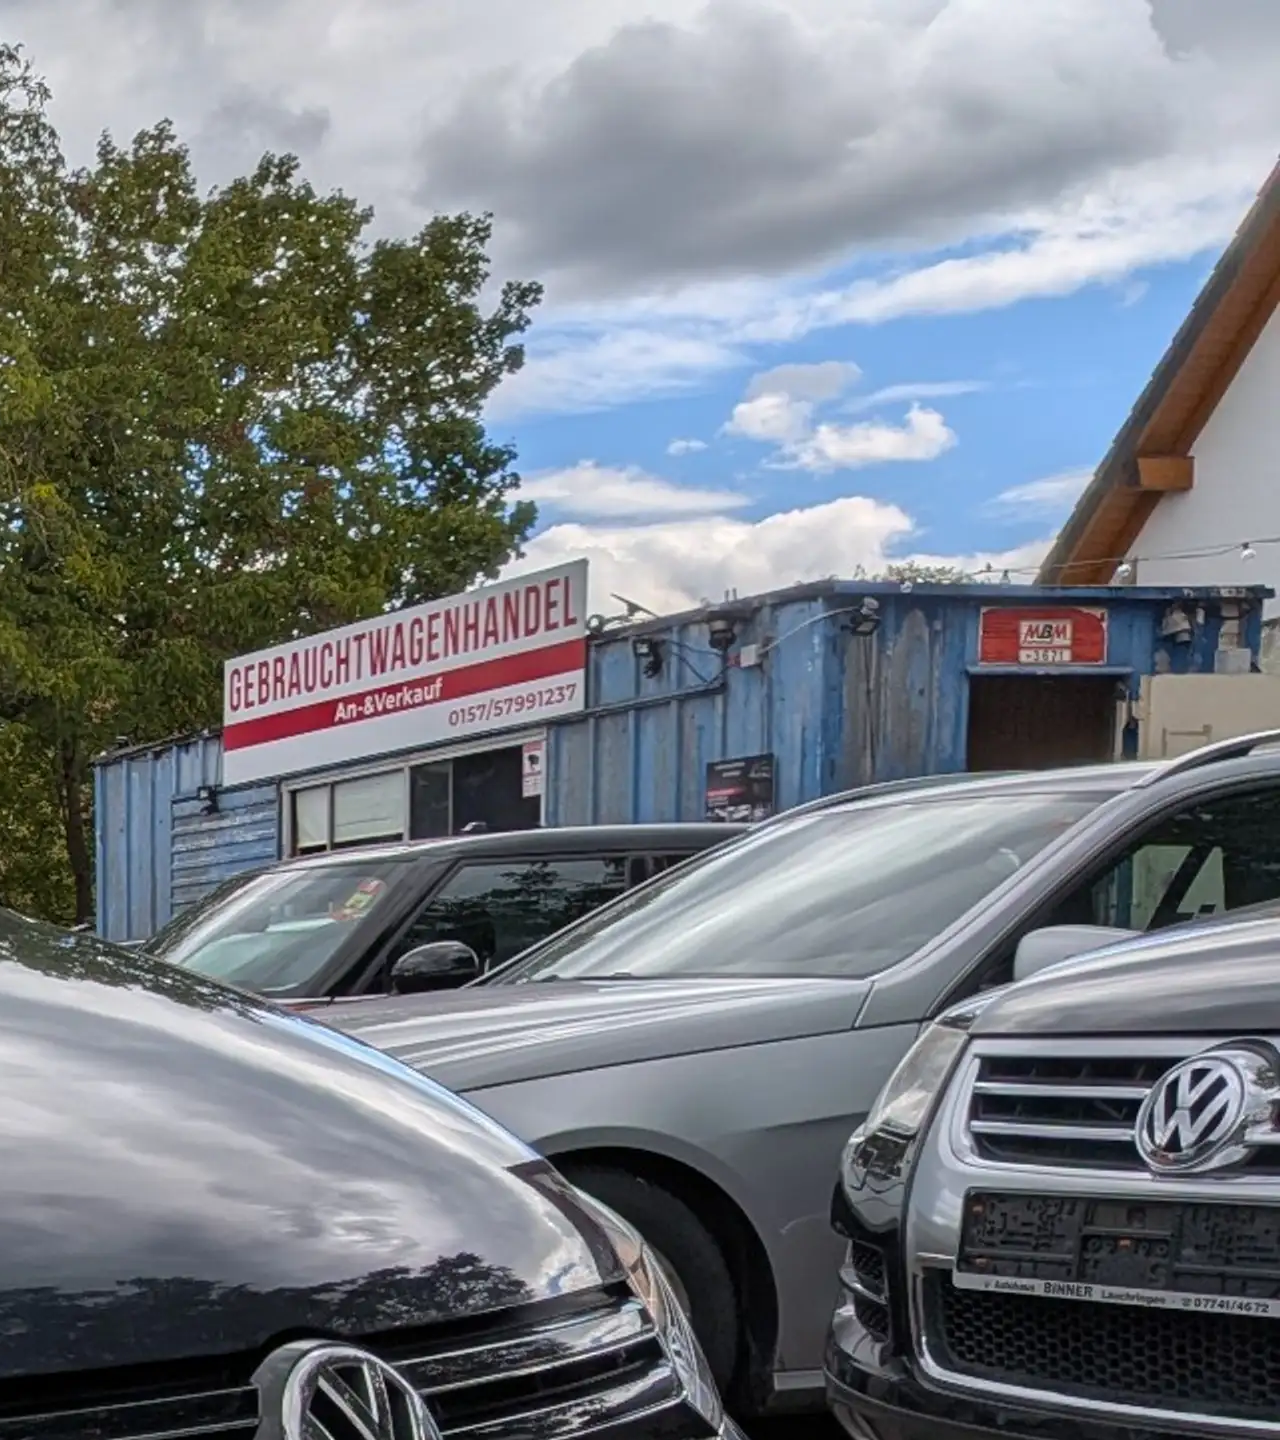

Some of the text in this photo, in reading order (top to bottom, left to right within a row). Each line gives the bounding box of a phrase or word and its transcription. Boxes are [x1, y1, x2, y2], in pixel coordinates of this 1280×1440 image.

[229, 576, 577, 712] GEBRAUCHTWAGENHANDEL
[1023, 624, 1068, 643] MBM
[334, 677, 443, 722] An-&Verkauf
[448, 683, 577, 727] 0157/57991237
[1043, 1282, 1093, 1297] BINNER
[1194, 1298, 1270, 1313] 07741/4672
